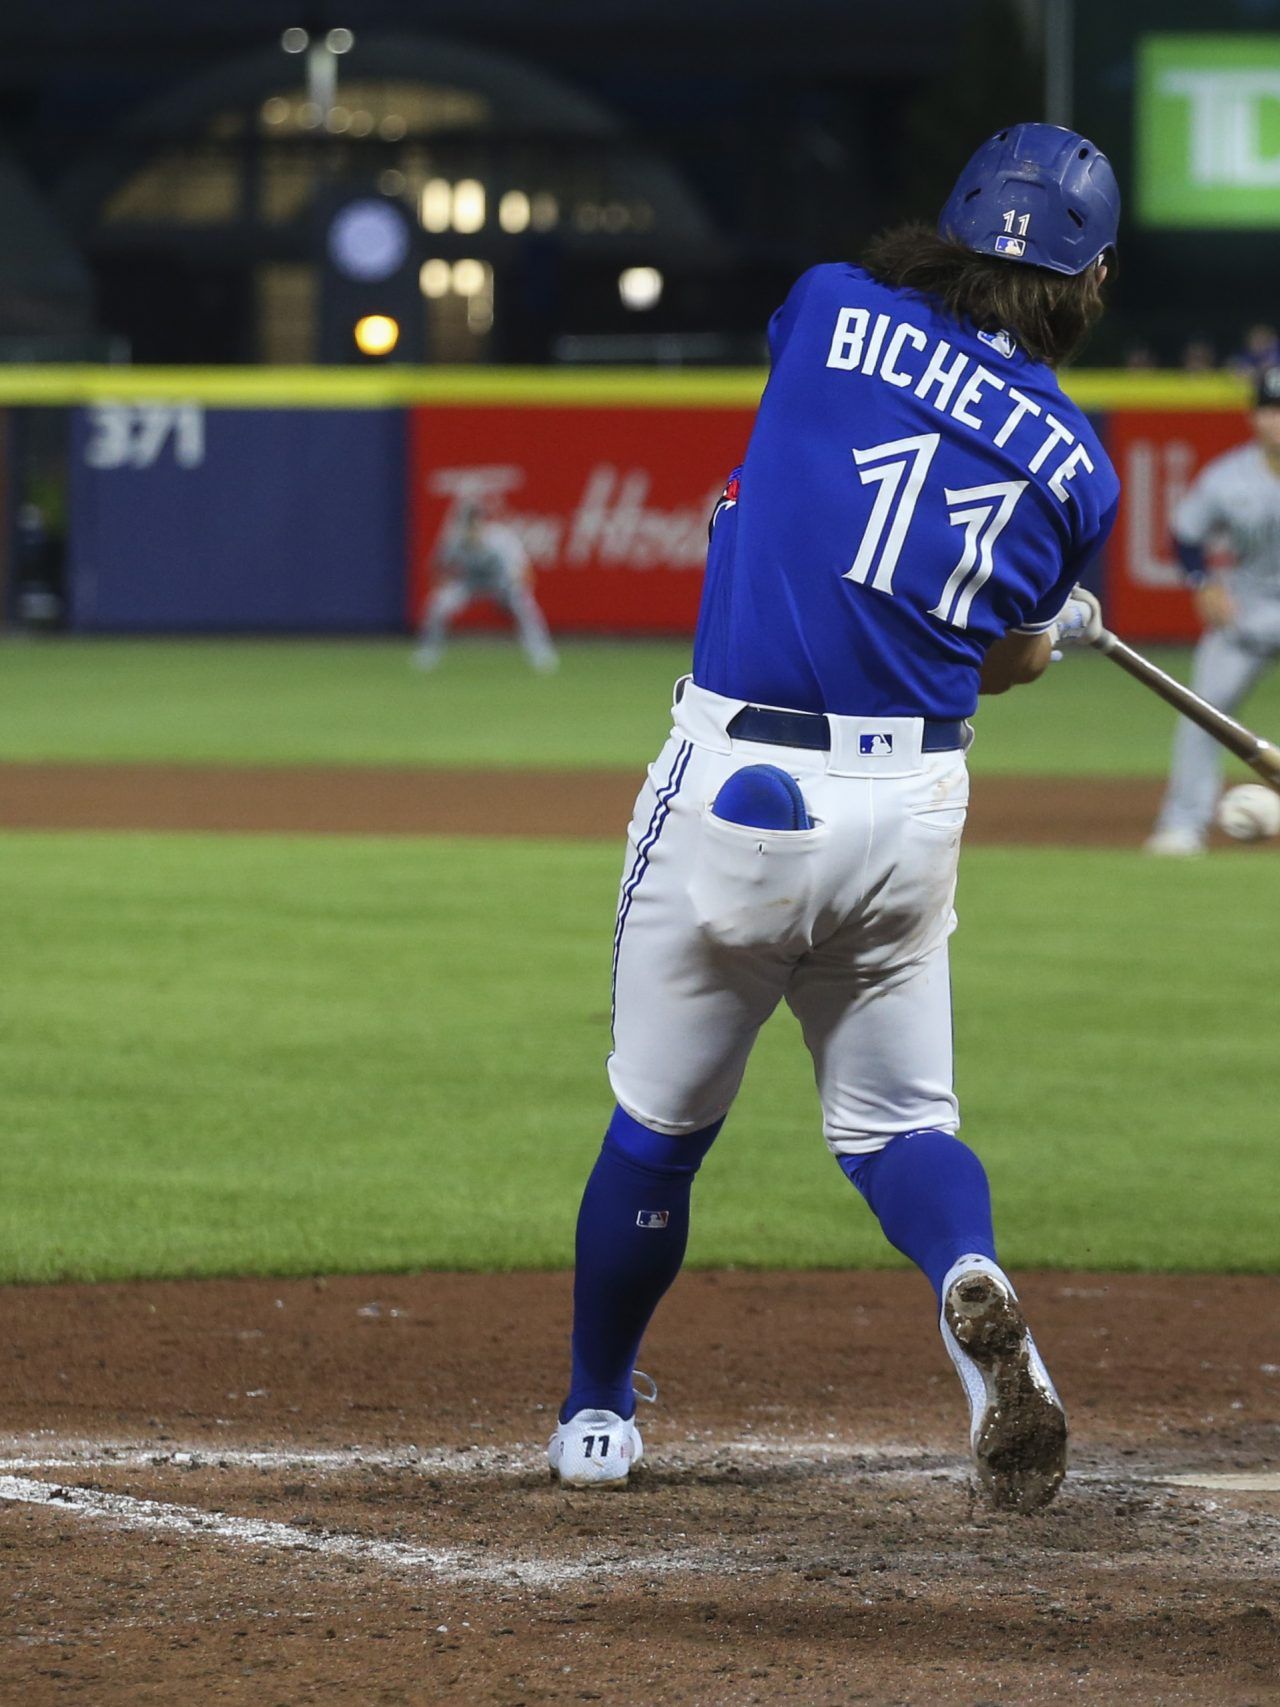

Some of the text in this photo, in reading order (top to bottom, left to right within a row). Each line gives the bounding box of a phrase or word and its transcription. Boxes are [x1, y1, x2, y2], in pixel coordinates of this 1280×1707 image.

[1002, 209, 1031, 237] 11
[84, 396, 205, 470] 371
[826, 306, 1096, 504] BICHETTE
[841, 432, 1030, 631] 11
[583, 1435, 610, 1458] 11
